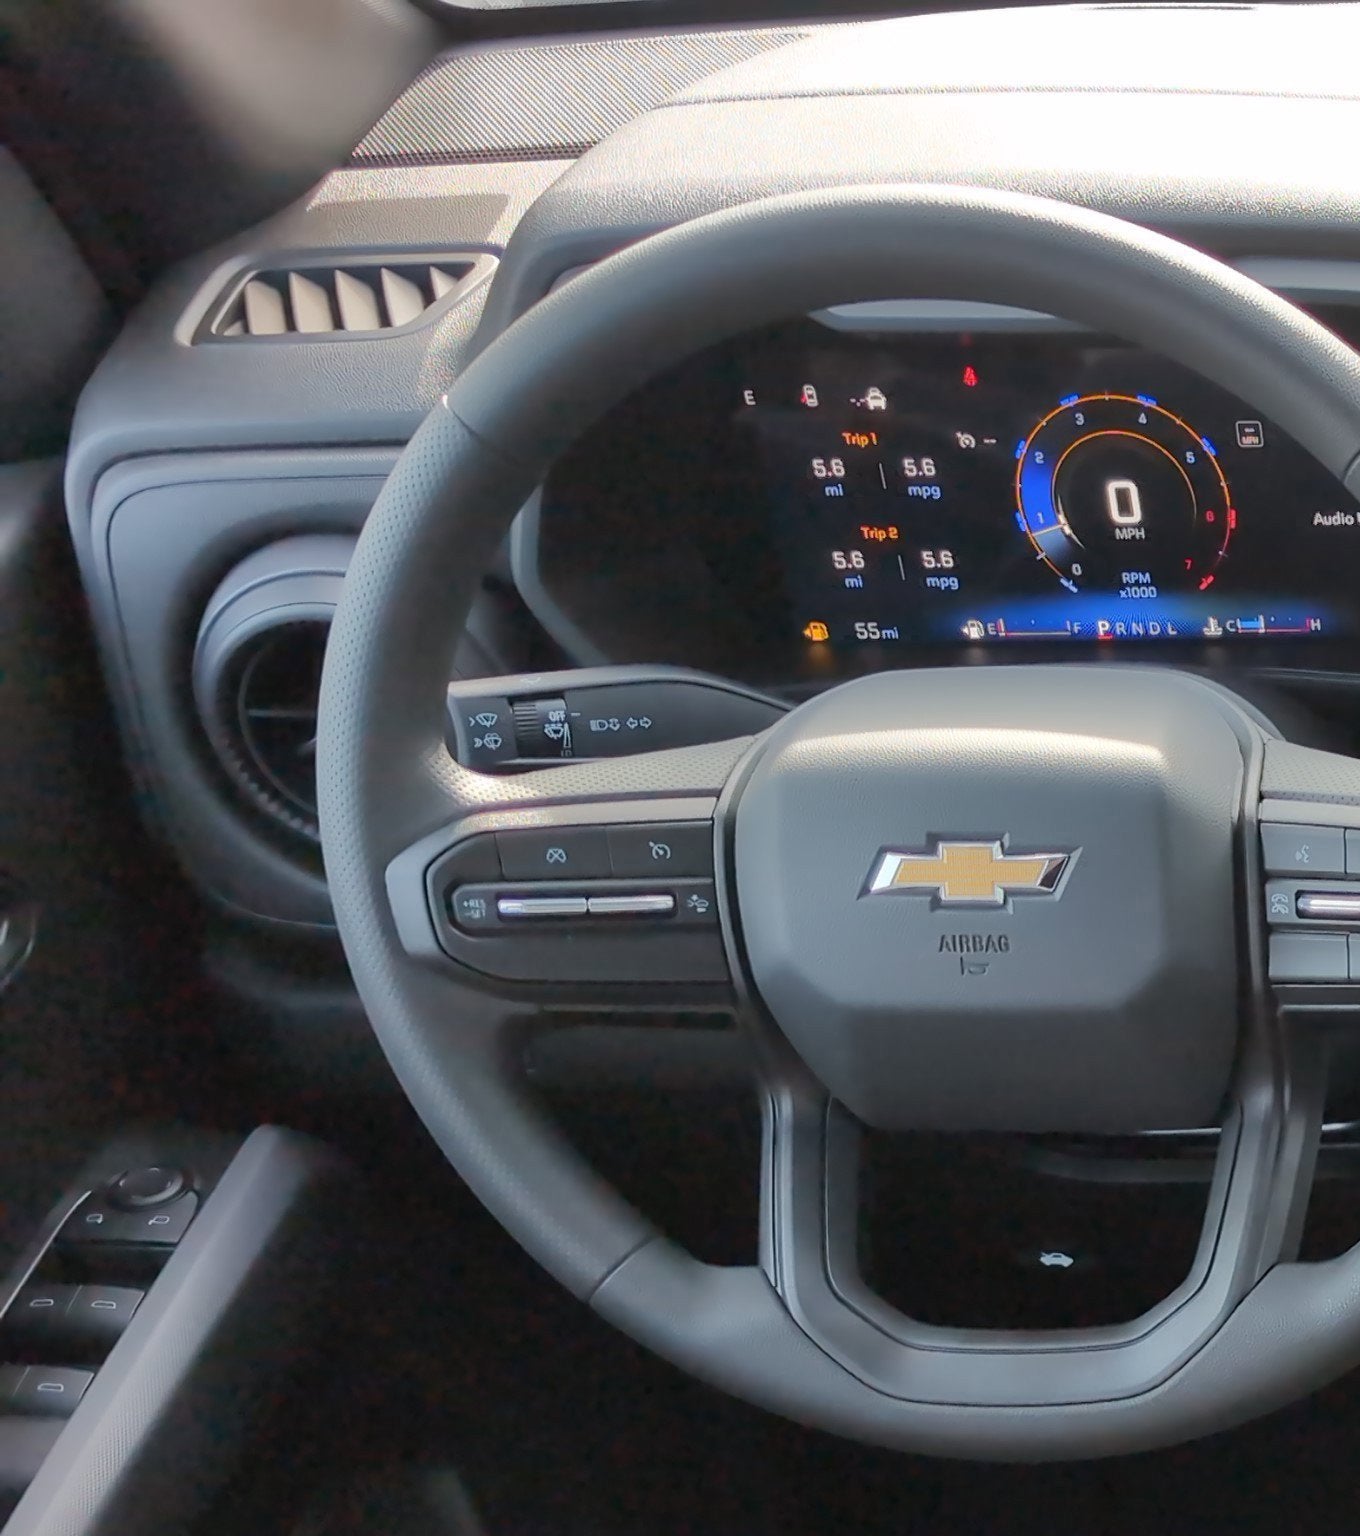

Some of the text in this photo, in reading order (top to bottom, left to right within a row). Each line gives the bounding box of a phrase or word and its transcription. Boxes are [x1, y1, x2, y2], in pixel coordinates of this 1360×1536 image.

[743, 389, 756, 406] E
[1075, 412, 1085, 426] 3
[1137, 412, 1147, 425] 4
[842, 432, 879, 449] Trip 1
[1034, 451, 1044, 464] 2
[1185, 451, 1196, 464] 5
[811, 456, 937, 479] 5.6 5.6
[824, 483, 941, 501] mi mpg
[1107, 480, 1142, 525] 0
[1036, 511, 1044, 524] 1
[1313, 512, 1354, 526] Audio
[860, 526, 899, 542] Trip 2
[1115, 526, 1146, 540] MPH
[831, 550, 955, 569] 5.6 5.6
[1185, 558, 1192, 570] 7
[1071, 562, 1082, 576] 0
[844, 575, 960, 591] mi mpg
[1122, 571, 1151, 585] RPM
[1119, 586, 1158, 600] x1000
[987, 622, 997, 635] E
[1099, 621, 1177, 635] P R N D L
[1310, 620, 1321, 632] H
[549, 710, 566, 721] OFF
[938, 934, 1010, 953] AIRBAG
